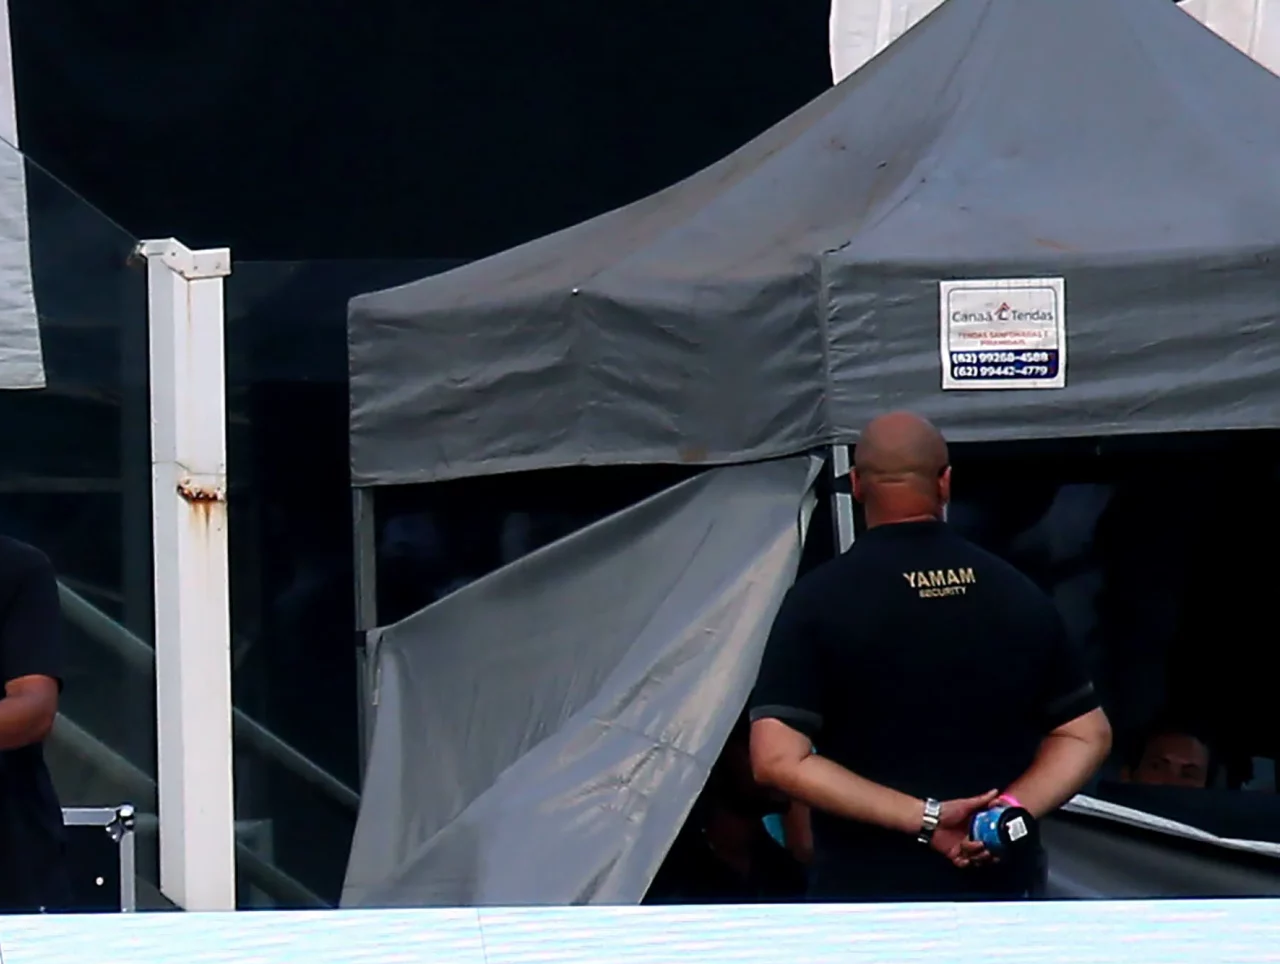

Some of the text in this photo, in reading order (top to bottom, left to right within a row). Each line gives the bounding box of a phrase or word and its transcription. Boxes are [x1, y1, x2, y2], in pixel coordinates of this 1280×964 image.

[1012, 309, 1054, 321] Tendas
[953, 366, 978, 378] (62)
[902, 567, 976, 588] YAMAM
